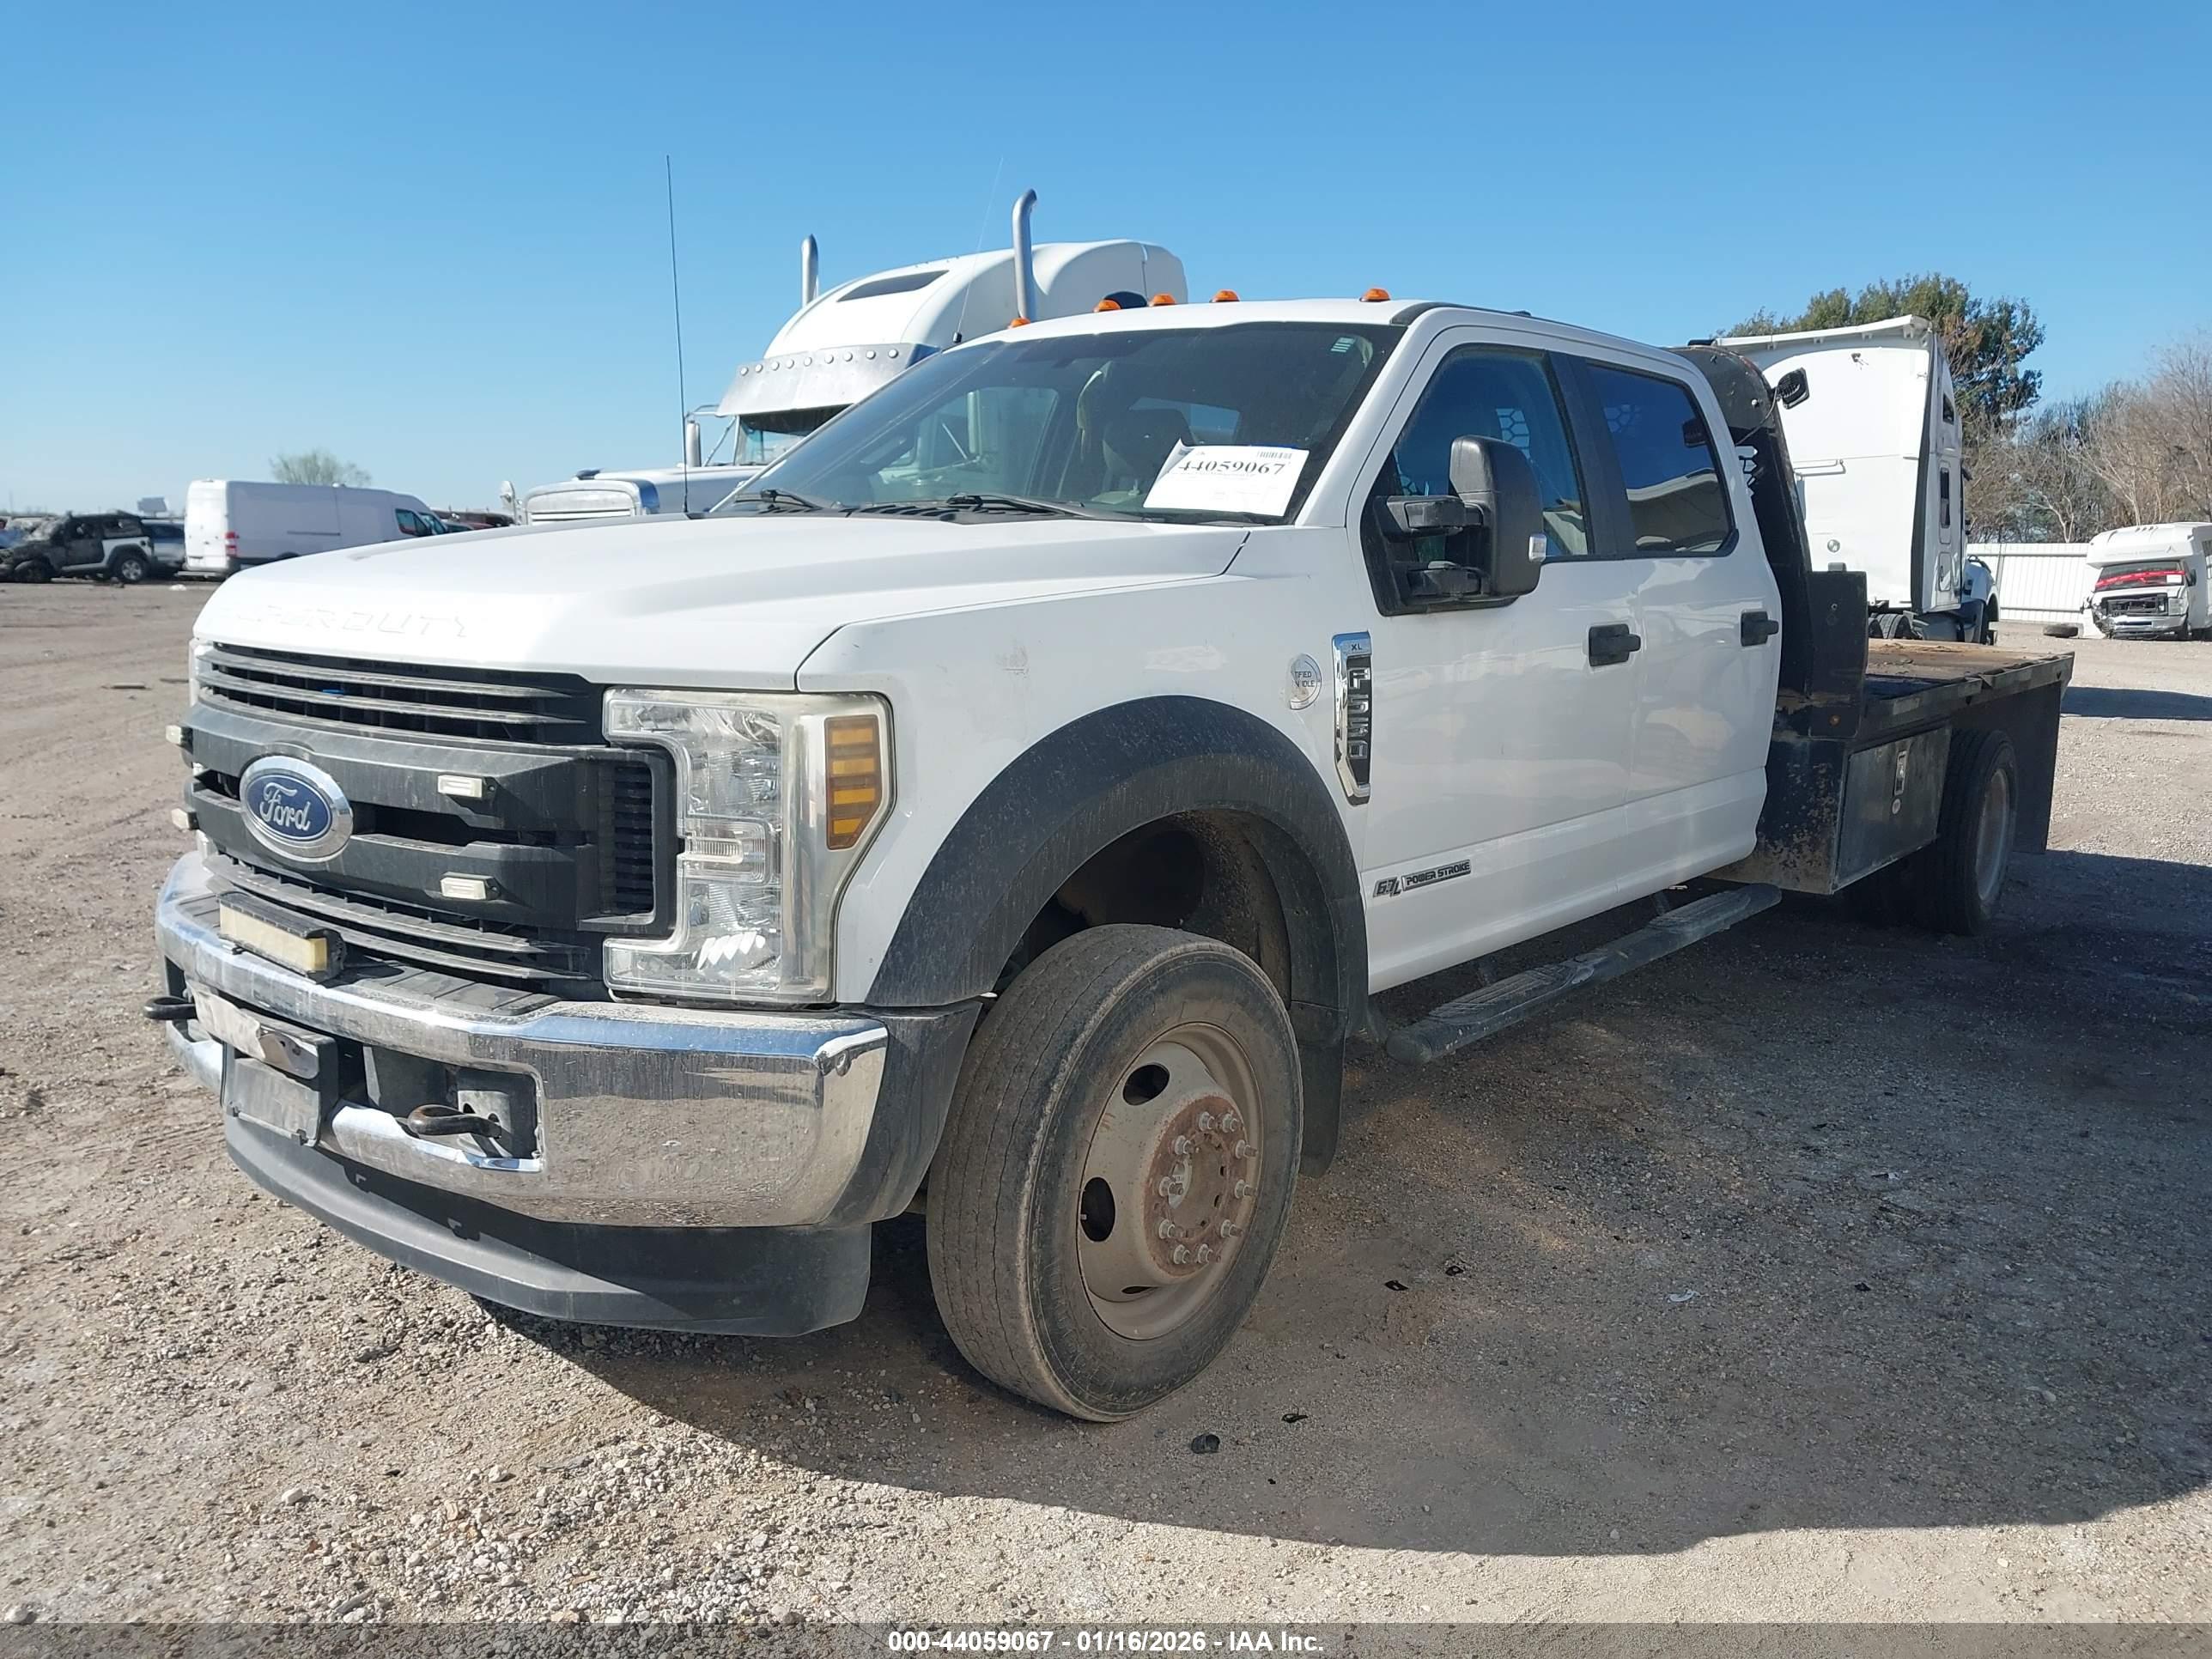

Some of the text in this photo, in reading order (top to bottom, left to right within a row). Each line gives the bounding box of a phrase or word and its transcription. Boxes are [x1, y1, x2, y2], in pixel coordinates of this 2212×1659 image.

[1178, 460, 1285, 475] 44059067
[342, 611, 468, 639] DUTY
[259, 782, 311, 831] Ford
[1407, 871, 1436, 885] POWER
[1437, 861, 1470, 878] STROKE
